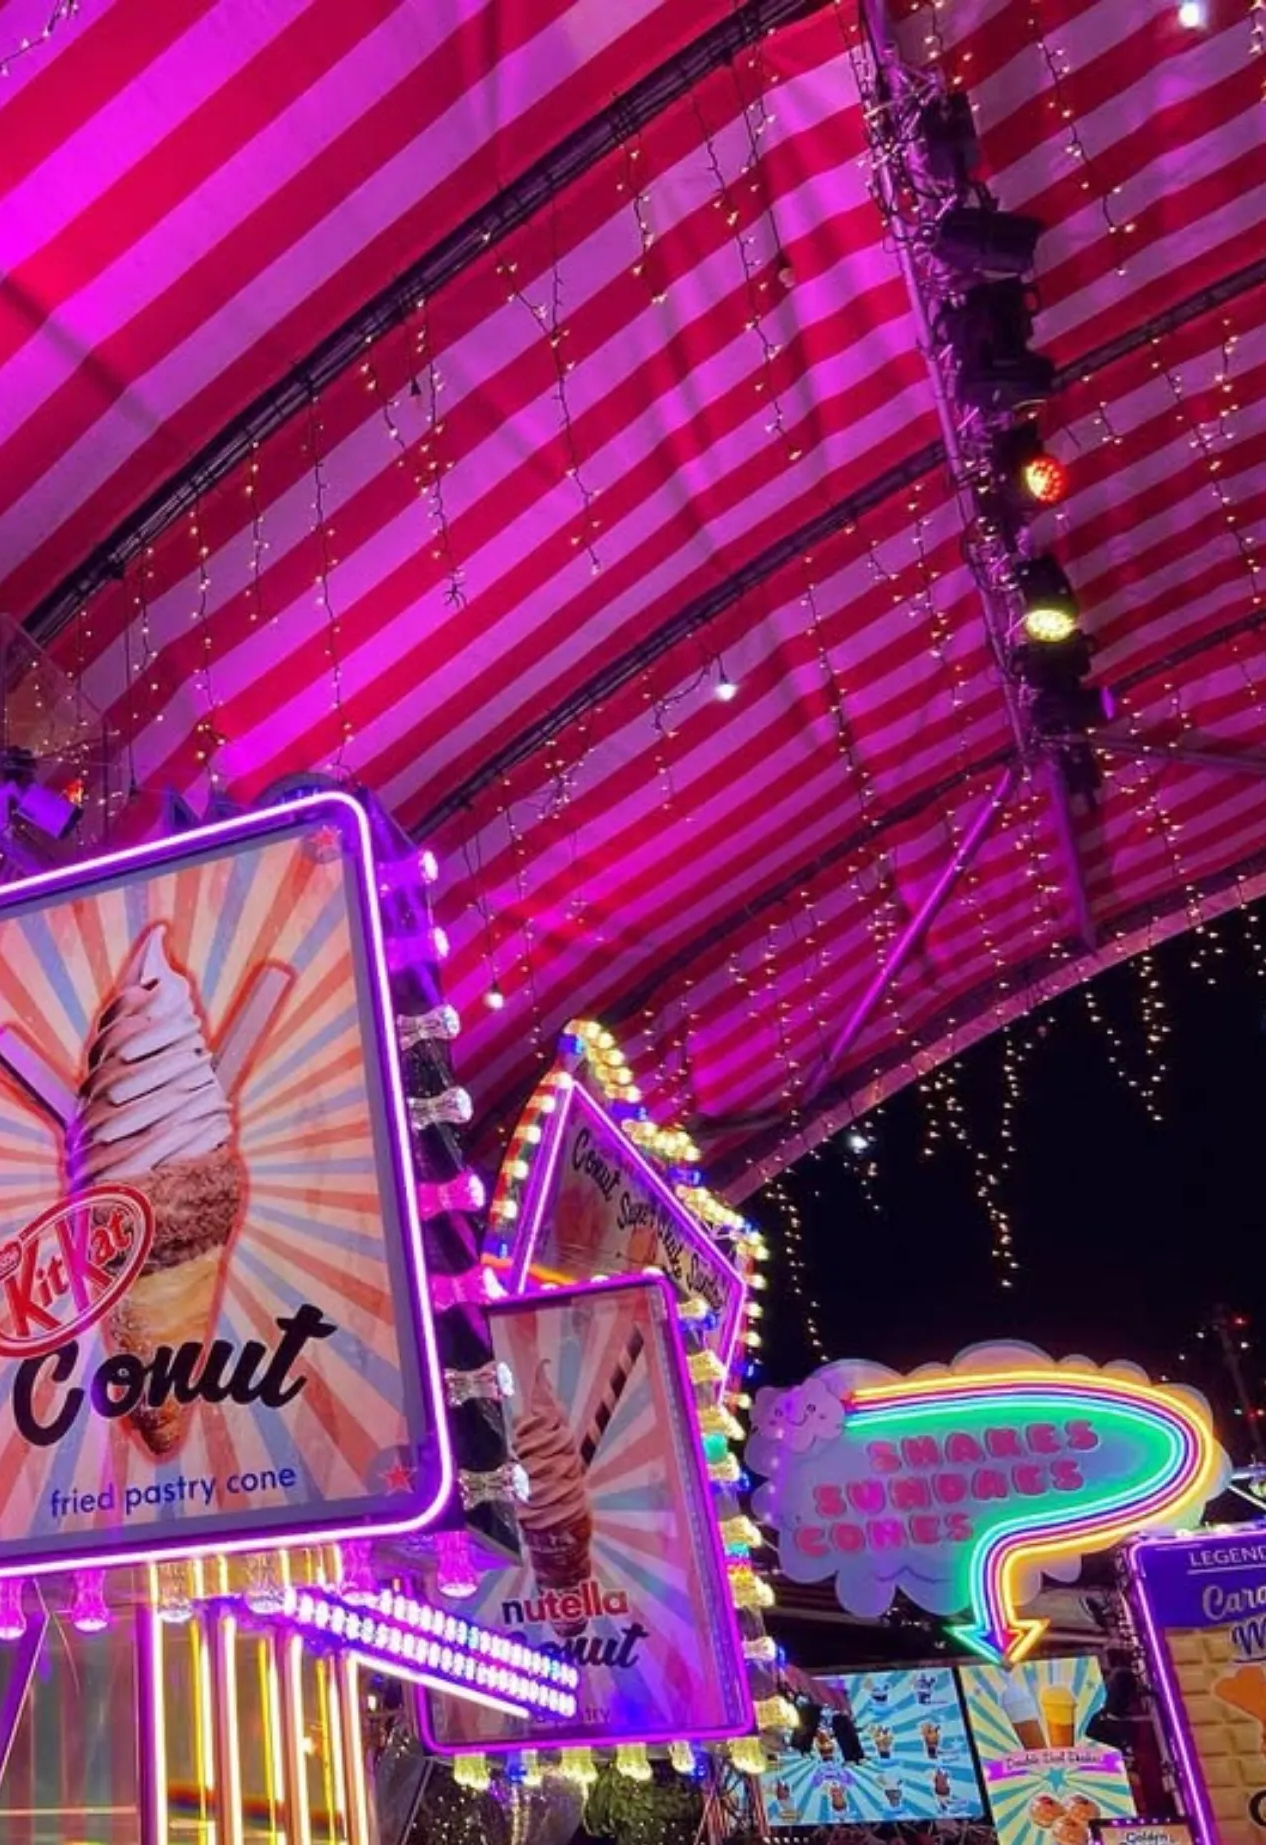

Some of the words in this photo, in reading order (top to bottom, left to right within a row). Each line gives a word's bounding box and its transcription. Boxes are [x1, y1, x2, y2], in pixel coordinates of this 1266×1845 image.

[4, 1206, 134, 1337] KitKat
[12, 1303, 337, 1447] Conut
[867, 1419, 1099, 1473] SHAKES
[51, 1484, 115, 1518] fried
[124, 1473, 219, 1514] pastry
[226, 1466, 296, 1495] cone
[813, 1459, 1084, 1518] SUNDAES
[794, 1512, 973, 1558] CONES
[502, 1580, 629, 1625] nutella
